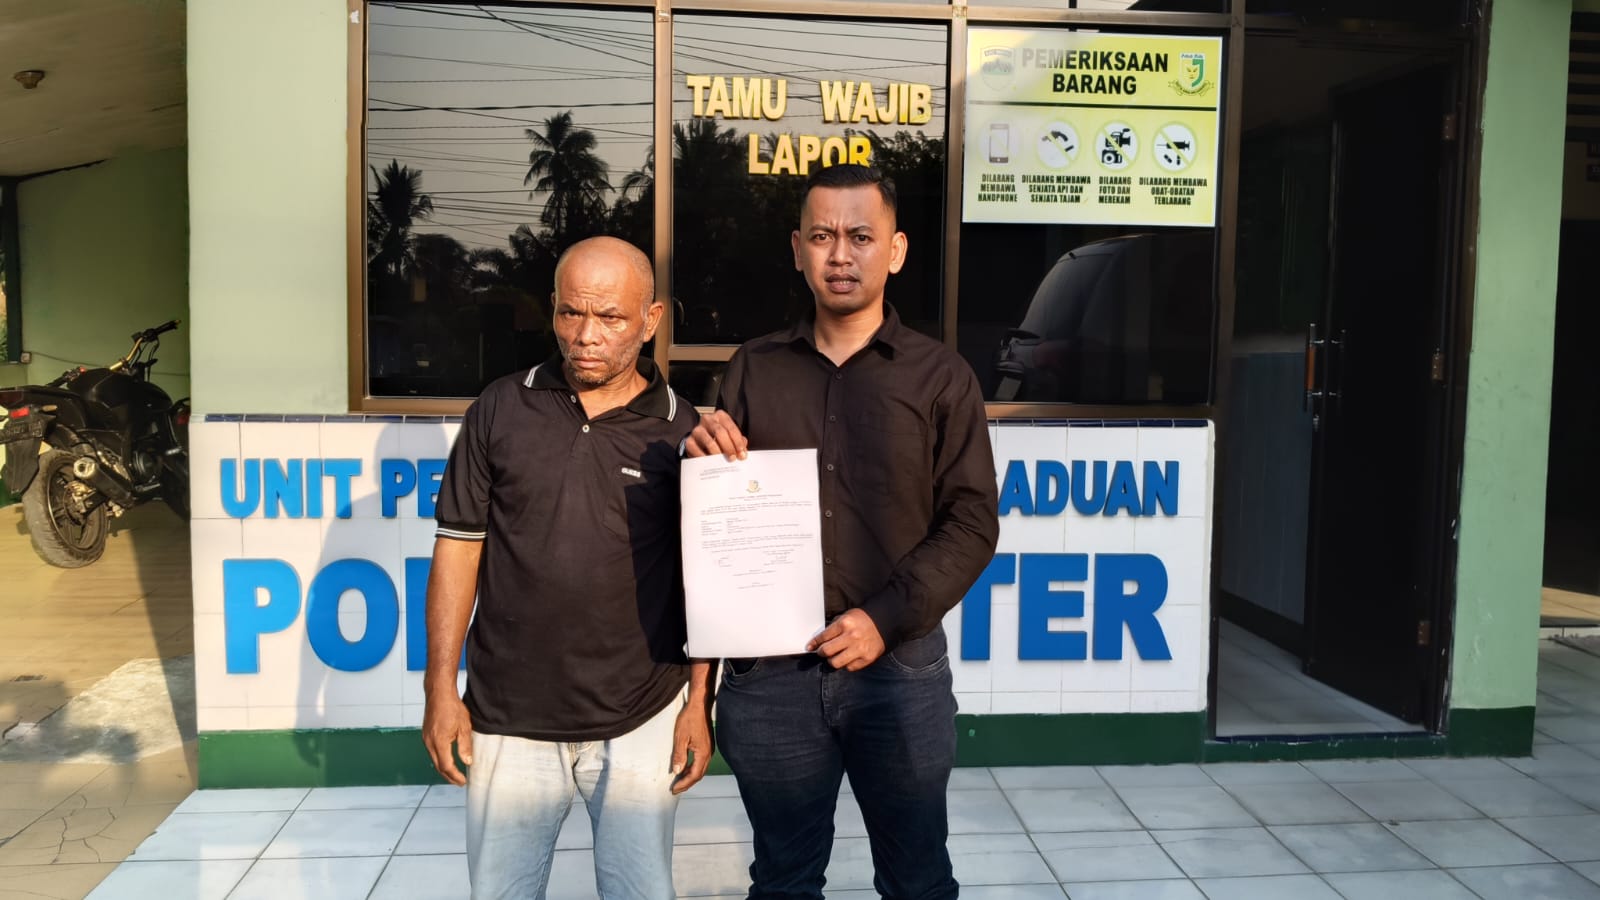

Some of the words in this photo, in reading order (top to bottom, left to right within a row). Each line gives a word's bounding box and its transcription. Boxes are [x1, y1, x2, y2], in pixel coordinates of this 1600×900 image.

[1022, 48, 1168, 73] PEMERIKSAAN
[1053, 74, 1137, 95] BARANG
[686, 75, 788, 120] TAMU
[820, 80, 933, 124] WAJIB
[748, 133, 872, 176] LAPOR
[982, 173, 1015, 183] DILARANG
[1021, 174, 1054, 184] DILARANG
[1056, 175, 1091, 185] MEMBAWA
[1098, 176, 1132, 185] DILARANG
[1139, 177, 1172, 186] DILARANG
[1173, 178, 1208, 187] MEMBAWA
[980, 183, 1016, 192] MEMBAWA
[1028, 184, 1056, 193] SENJATA
[1057, 185, 1069, 193] API
[1069, 185, 1083, 194] DAN
[1098, 186, 1116, 194] FOTO
[1117, 186, 1131, 195] DAN
[1151, 187, 1195, 196] OBAT-OBATAN
[978, 193, 1018, 202] HANDPHONE
[1030, 194, 1058, 203] SENJATA
[1059, 194, 1081, 203] TAJAM
[1098, 195, 1131, 204] MEREKAM
[1154, 196, 1191, 206] TERLARANG
[220, 458, 363, 519] UNIT
[998, 460, 1179, 517] ADUAN
